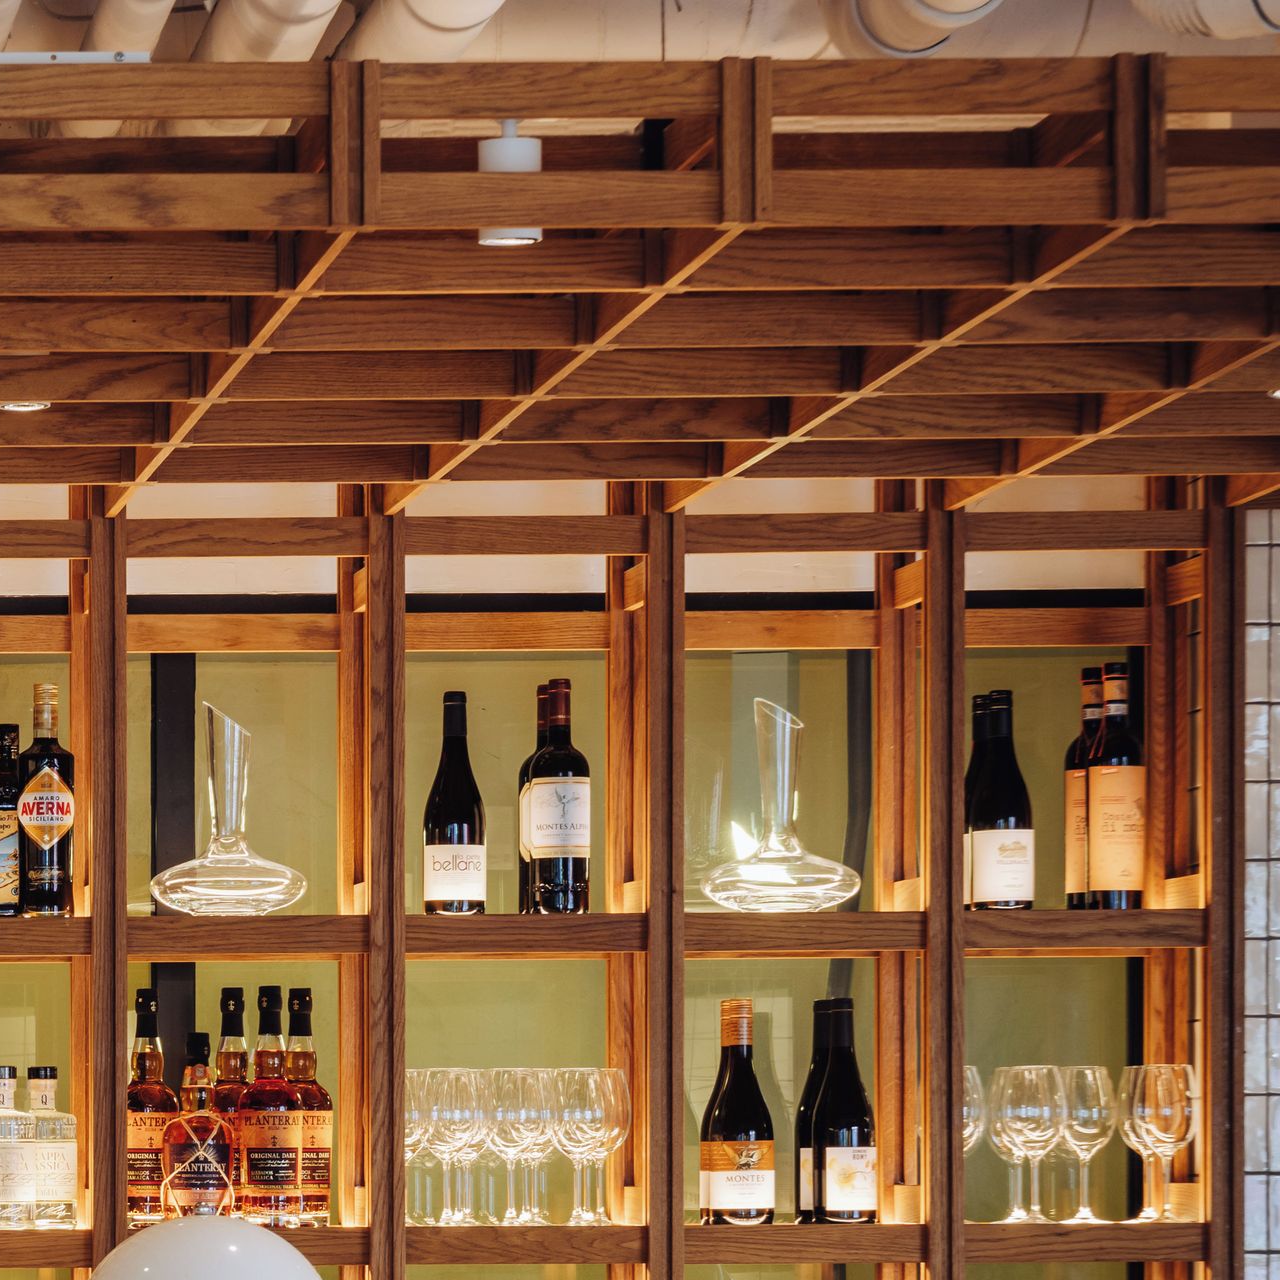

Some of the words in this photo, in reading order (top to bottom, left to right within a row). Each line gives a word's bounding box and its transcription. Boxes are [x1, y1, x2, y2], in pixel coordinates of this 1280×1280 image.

[20, 801, 72, 816] AVERNA
[535, 823, 568, 832] MONTES
[432, 854, 482, 872] bellane
[244, 1115, 300, 1126] PLANTERAY
[725, 1174, 765, 1183] MONTES
